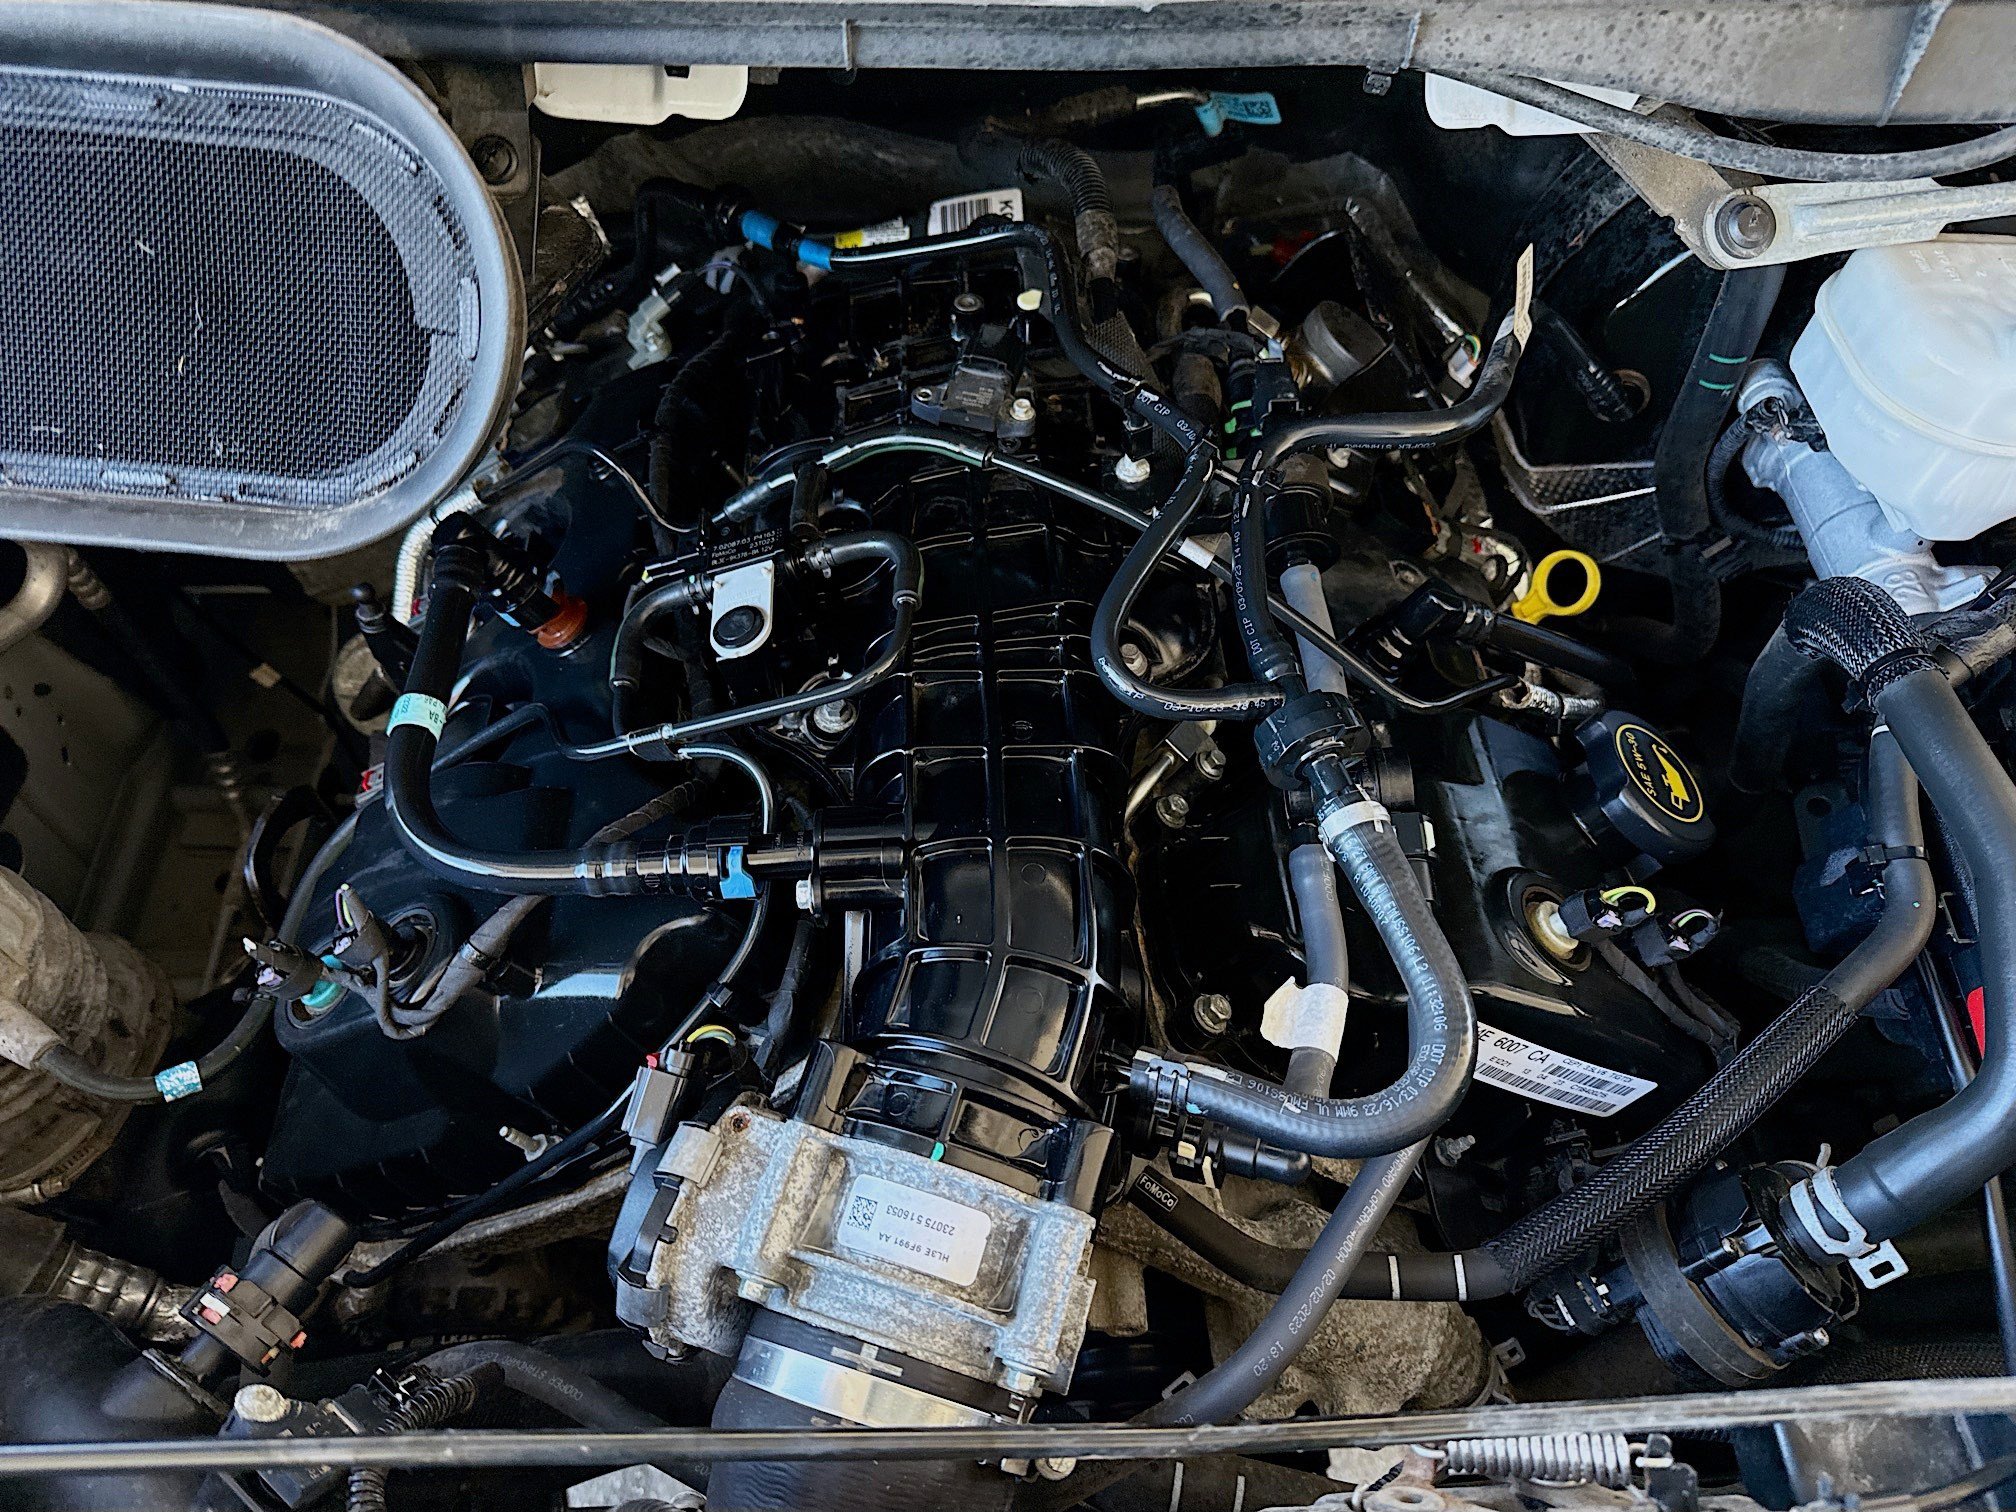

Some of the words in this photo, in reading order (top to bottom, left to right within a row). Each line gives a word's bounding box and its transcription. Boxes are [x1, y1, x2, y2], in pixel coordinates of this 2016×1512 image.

[1153, 402, 1171, 418] CIP
[1233, 565, 1246, 611] 03/09/23
[1243, 617, 1255, 636] CIP
[1625, 731, 1647, 771] 5W-30
[1640, 771, 1657, 797] SAE
[1420, 976, 1448, 1031] 11:32:06
[1431, 1044, 1447, 1066] DOT
[1493, 1036, 1529, 1054] 6007
[1527, 1050, 1551, 1065] CA
[1415, 1067, 1437, 1088] CIP
[1335, 1106, 1359, 1119] 9MM
[1364, 1087, 1419, 1117] 03/16/23
[1138, 1174, 1176, 1208] FoMoCo
[885, 1204, 923, 1225] 516053
[878, 1231, 890, 1243] AA
[924, 1218, 956, 1236] 23075
[893, 1236, 923, 1253] 9F991
[923, 1247, 950, 1263] HL3E
[1287, 1267, 1337, 1335] 02/02/2023
[1252, 1340, 1285, 1377] 18:20
